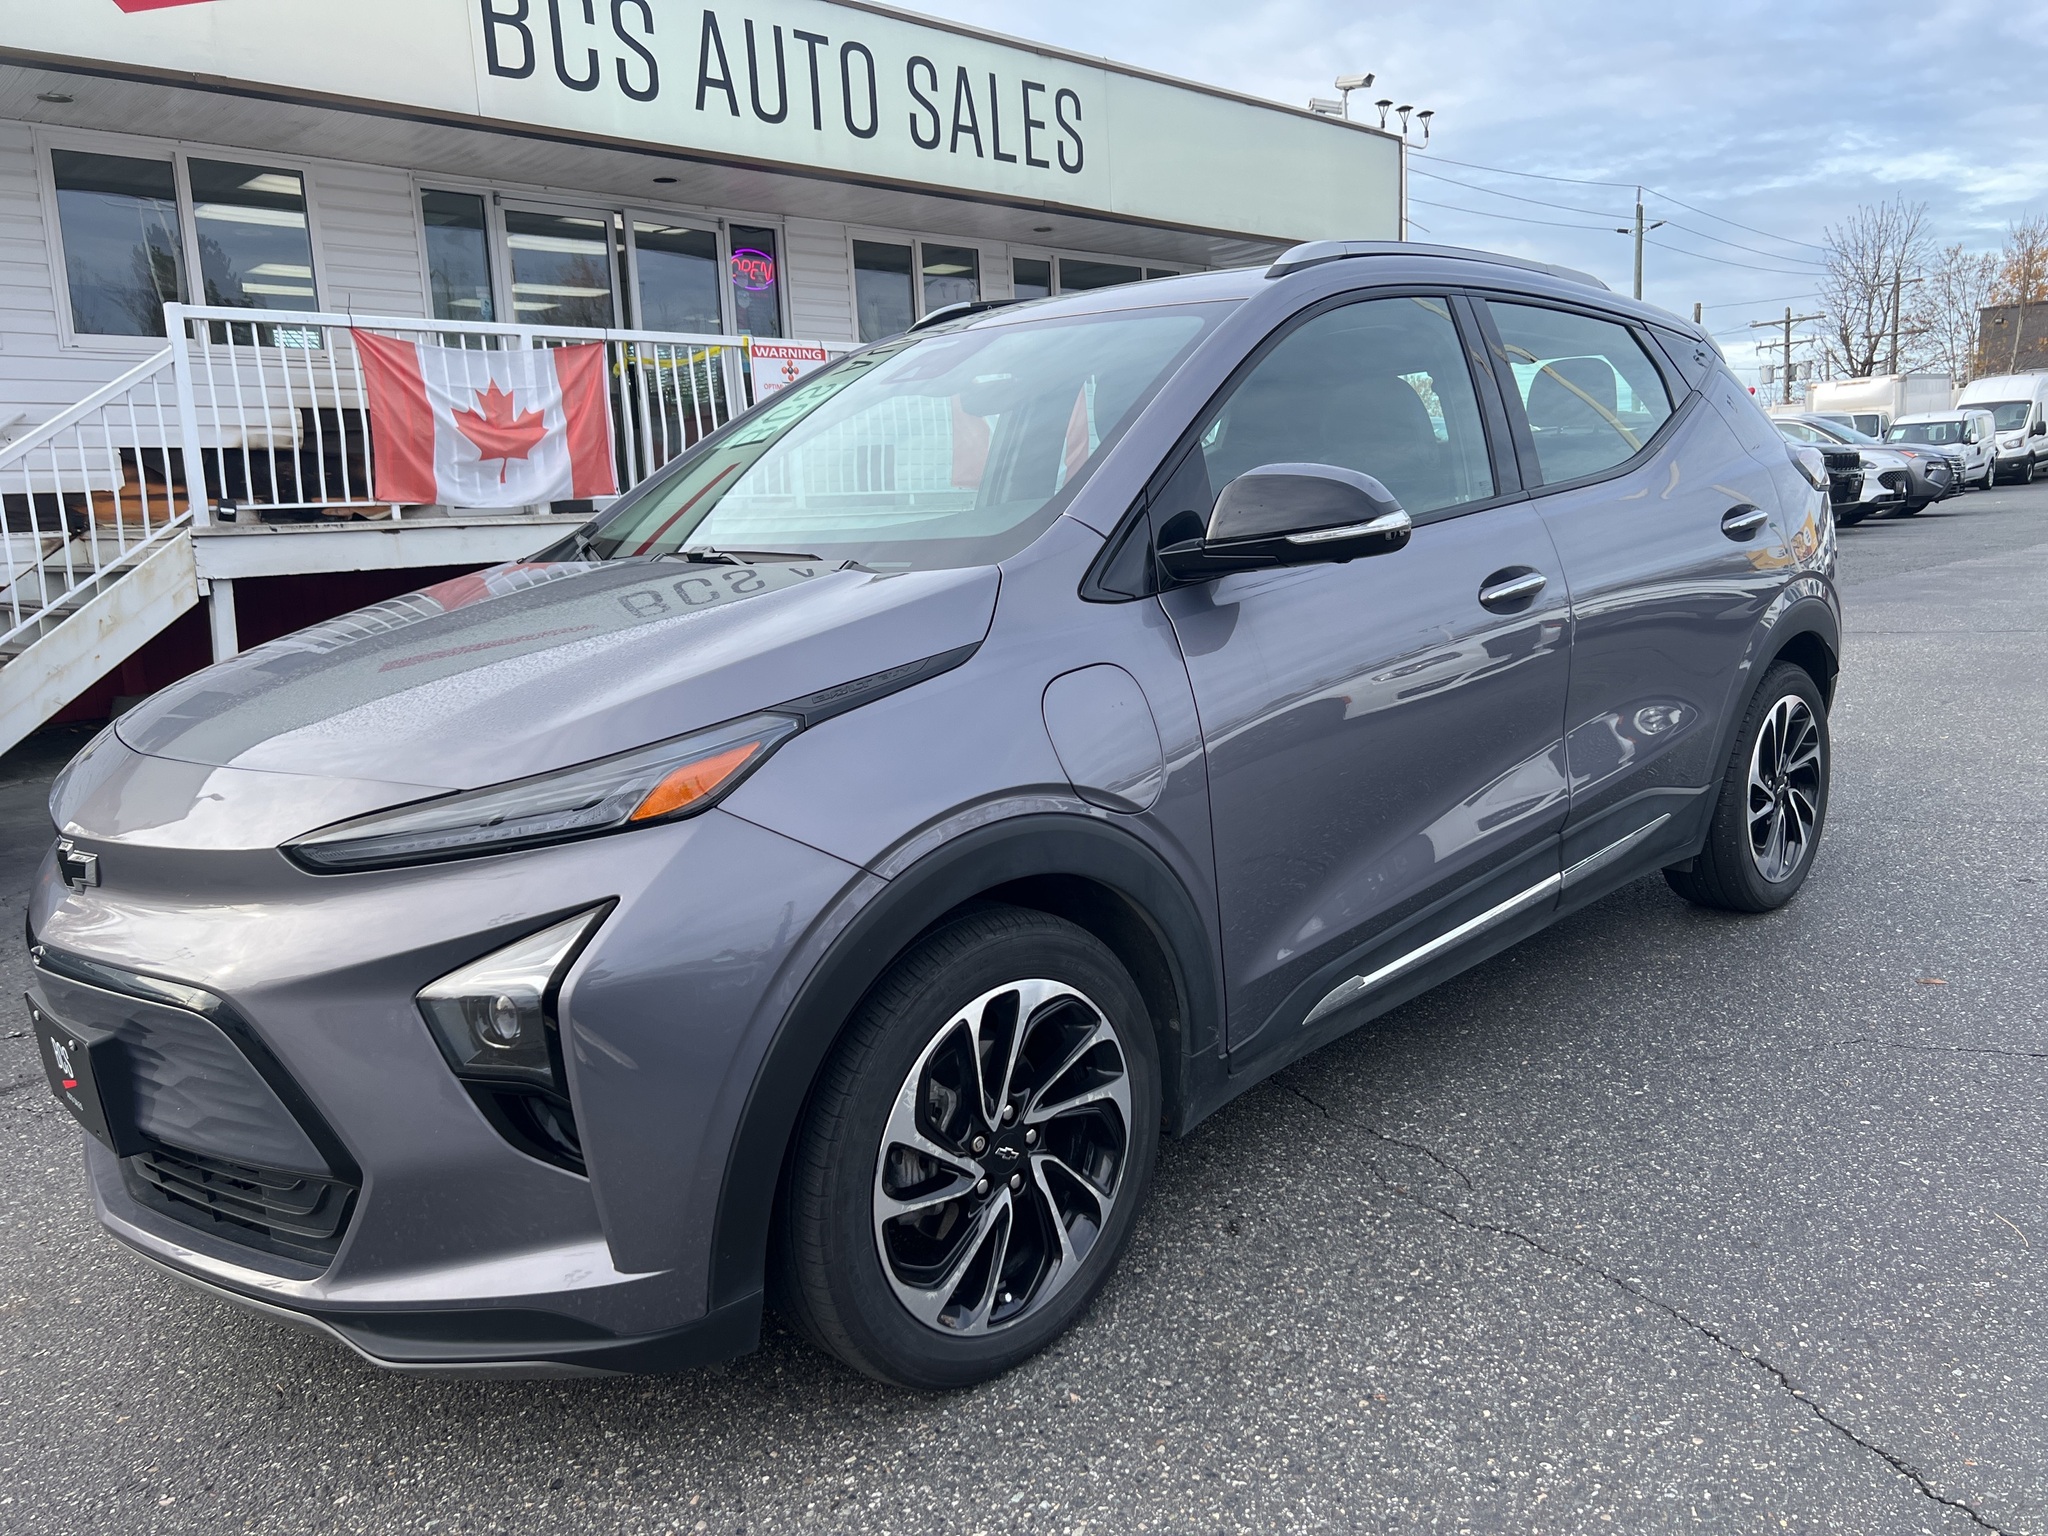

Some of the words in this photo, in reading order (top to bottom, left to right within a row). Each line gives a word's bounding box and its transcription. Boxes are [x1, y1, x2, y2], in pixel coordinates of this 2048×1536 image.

[481, 0, 659, 102] BCS
[695, 10, 879, 139] AUTO
[906, 55, 1085, 174] SALES
[731, 258, 773, 282] OPEN
[754, 346, 822, 360] WARNING
